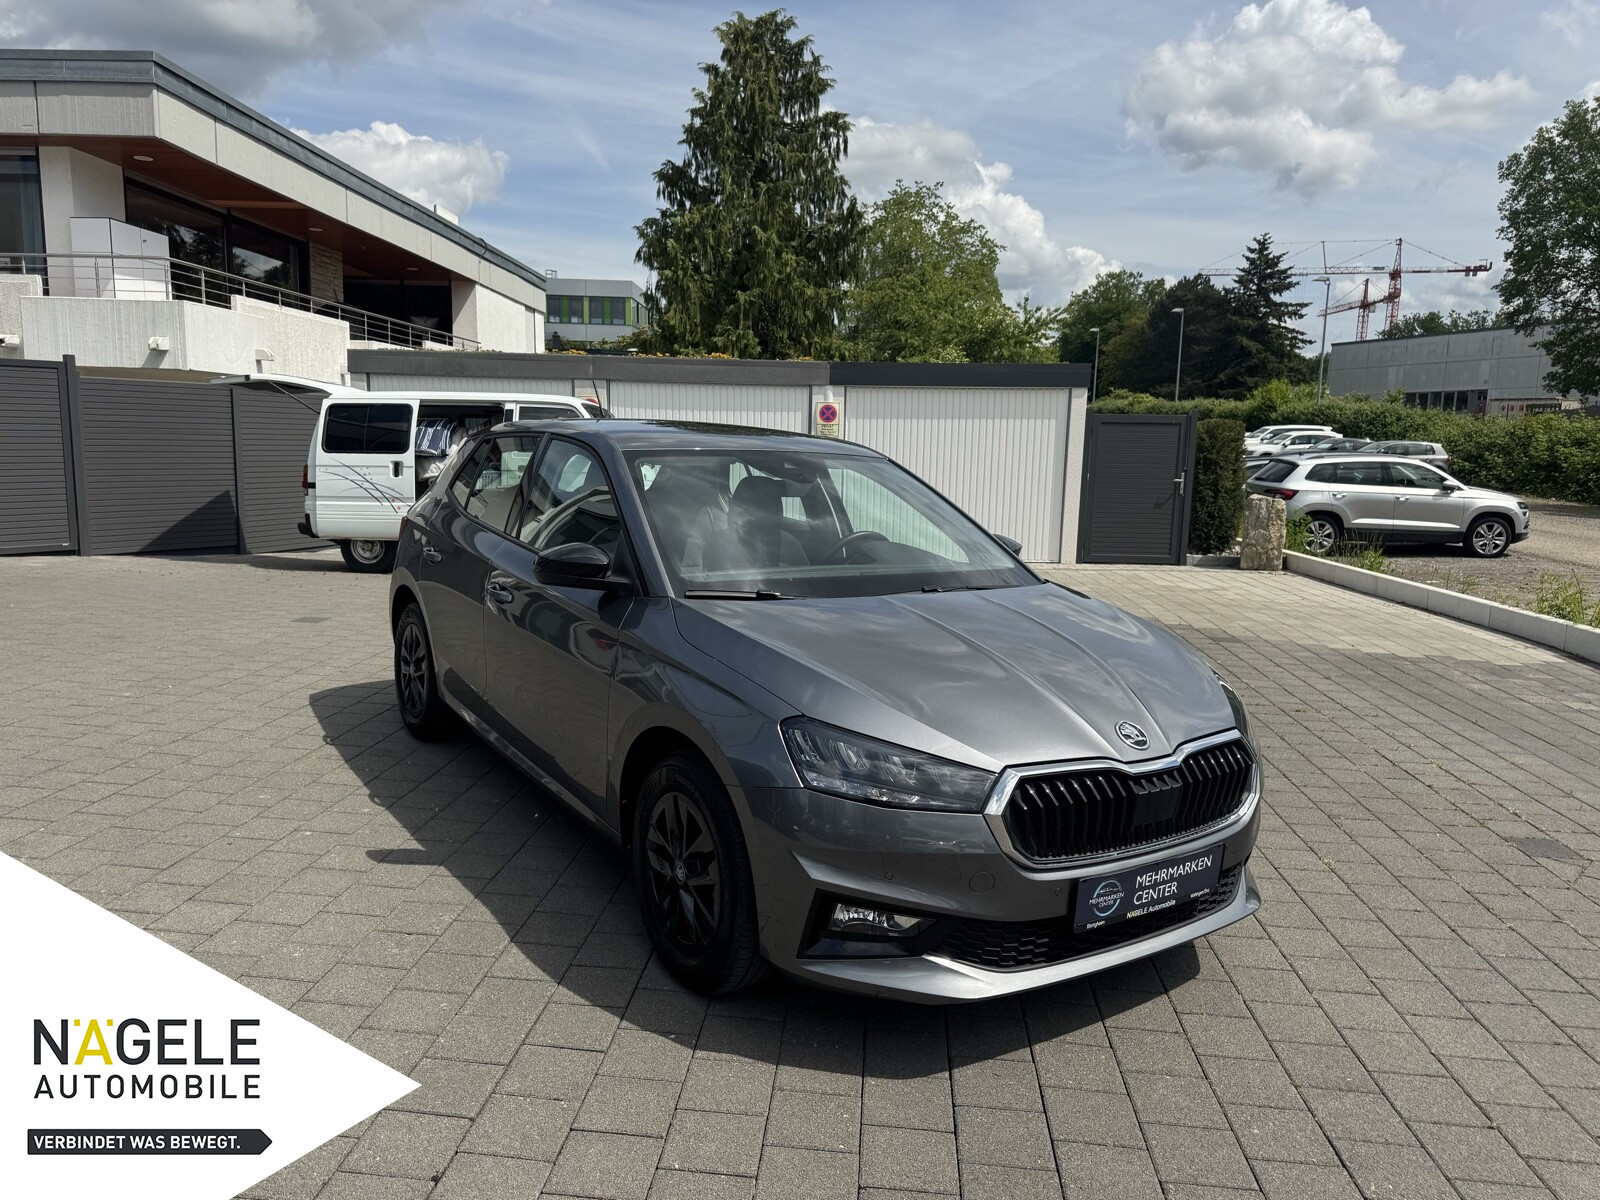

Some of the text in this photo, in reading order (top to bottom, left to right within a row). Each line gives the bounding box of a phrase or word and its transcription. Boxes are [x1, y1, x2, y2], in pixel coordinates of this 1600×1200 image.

[1135, 855, 1213, 888] MEHRMARKEN
[1088, 891, 1125, 906] MEHRMARKEN
[1133, 881, 1178, 905] CENTER
[1098, 900, 1114, 908] CENTER
[1147, 899, 1176, 912] Automobile
